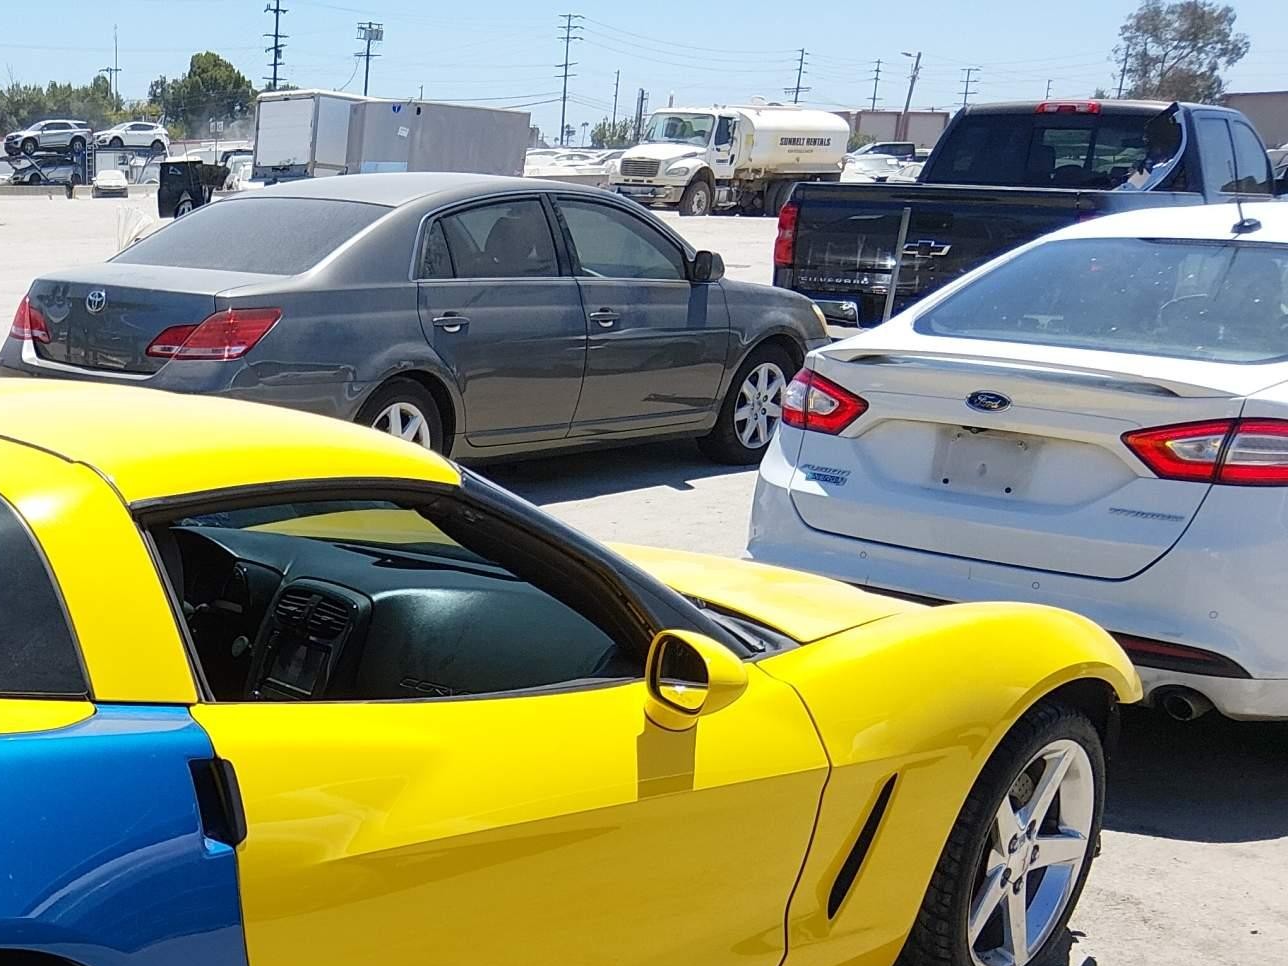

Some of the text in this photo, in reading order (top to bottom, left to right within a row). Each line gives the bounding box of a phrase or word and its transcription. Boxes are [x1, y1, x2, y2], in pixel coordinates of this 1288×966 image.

[779, 137, 831, 146] SUNBELT RENTALS
[970, 392, 1006, 410] Ford
